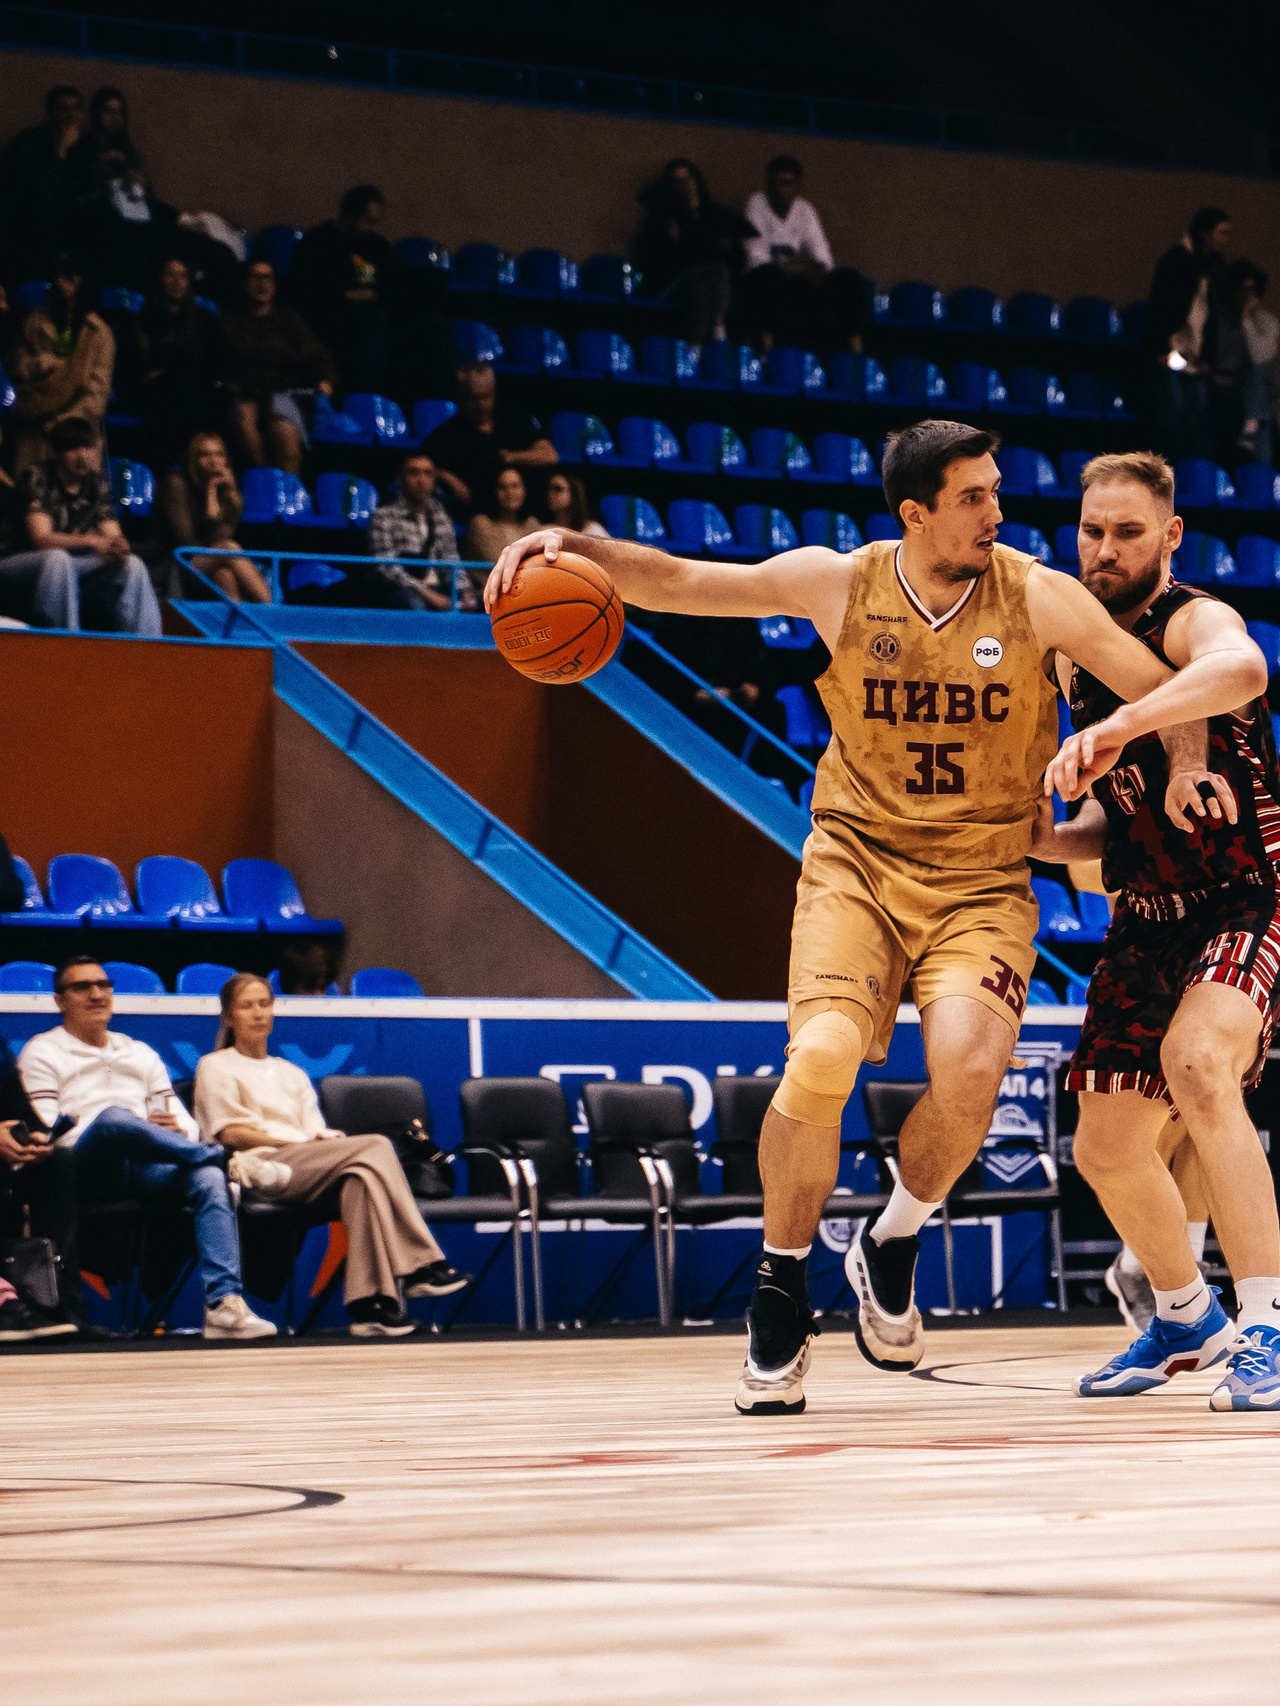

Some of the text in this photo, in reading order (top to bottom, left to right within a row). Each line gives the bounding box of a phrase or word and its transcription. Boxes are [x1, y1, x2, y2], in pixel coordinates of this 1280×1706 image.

[975, 647, 999, 656] РФБ
[863, 678, 1010, 726] ЦИВС
[906, 742, 965, 794] 35
[1107, 763, 1147, 815] 41
[1199, 930, 1255, 965] 41
[979, 953, 1027, 1021] 35
[1029, 1076, 1046, 1100] 4
